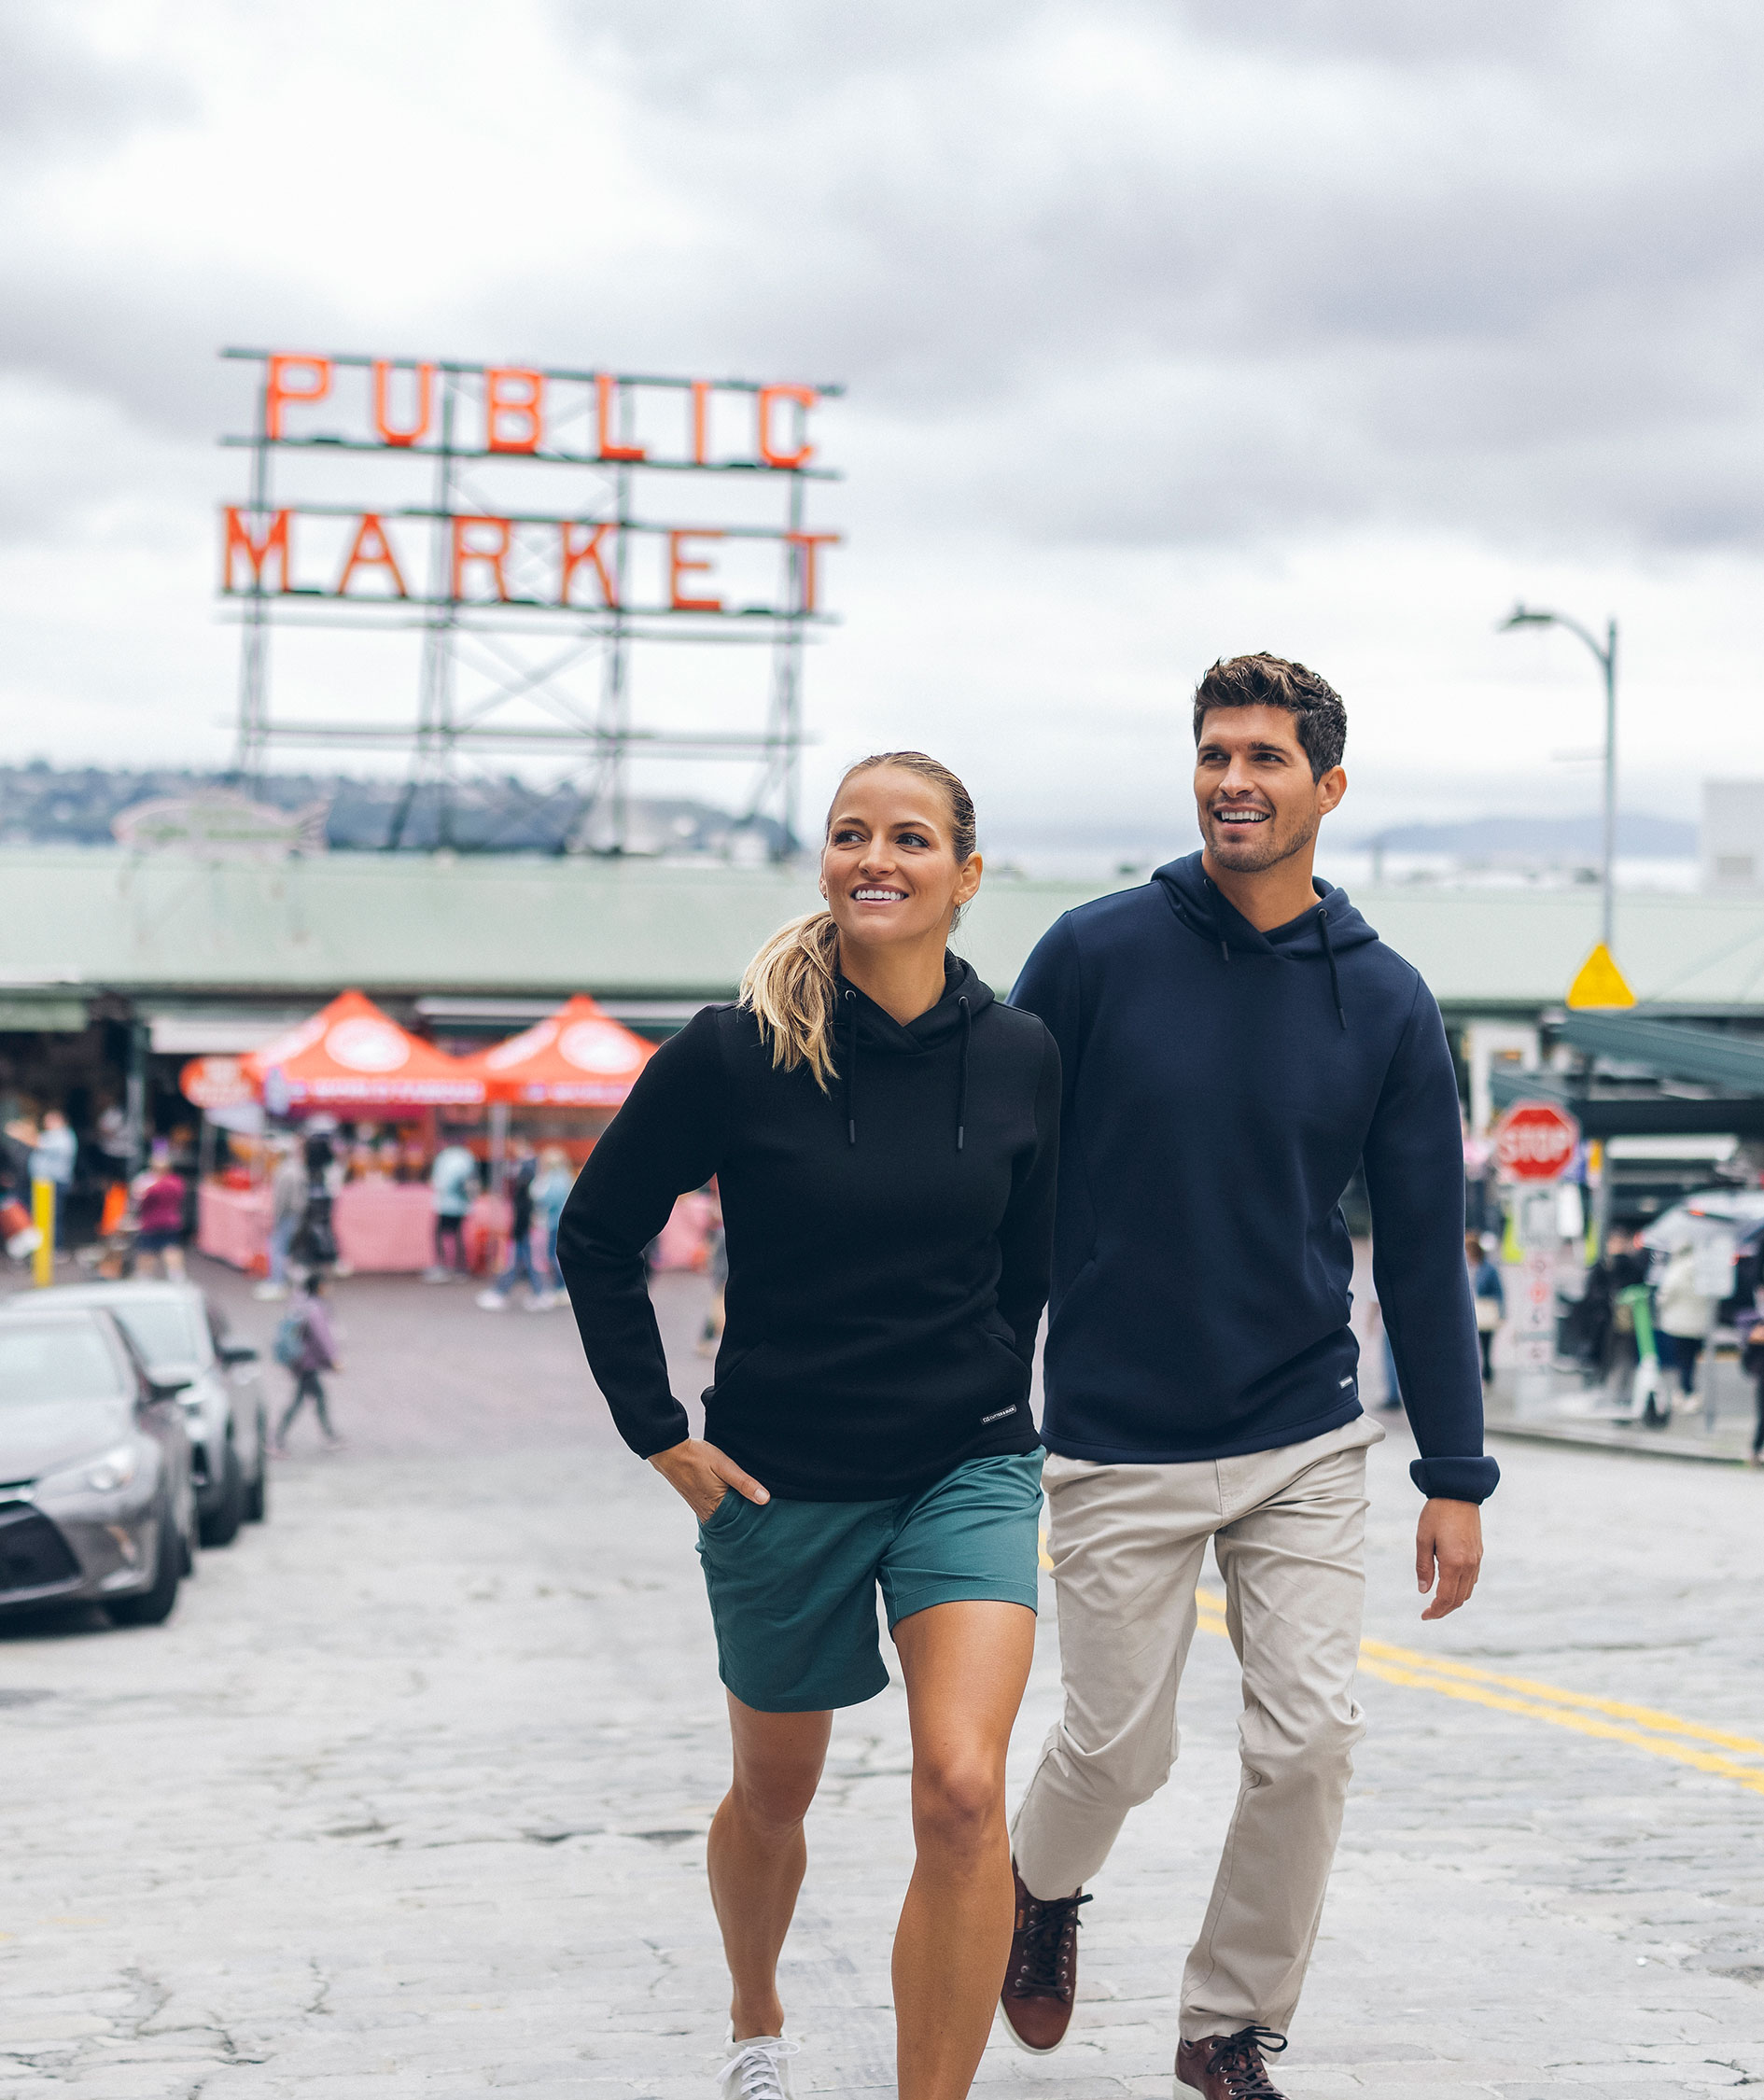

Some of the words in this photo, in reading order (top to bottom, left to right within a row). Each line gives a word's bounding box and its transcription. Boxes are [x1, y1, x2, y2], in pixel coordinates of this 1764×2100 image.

[265, 354, 819, 469] PUBLIC
[222, 506, 842, 614] MARKET
[1497, 1124, 1571, 1163] STOP
